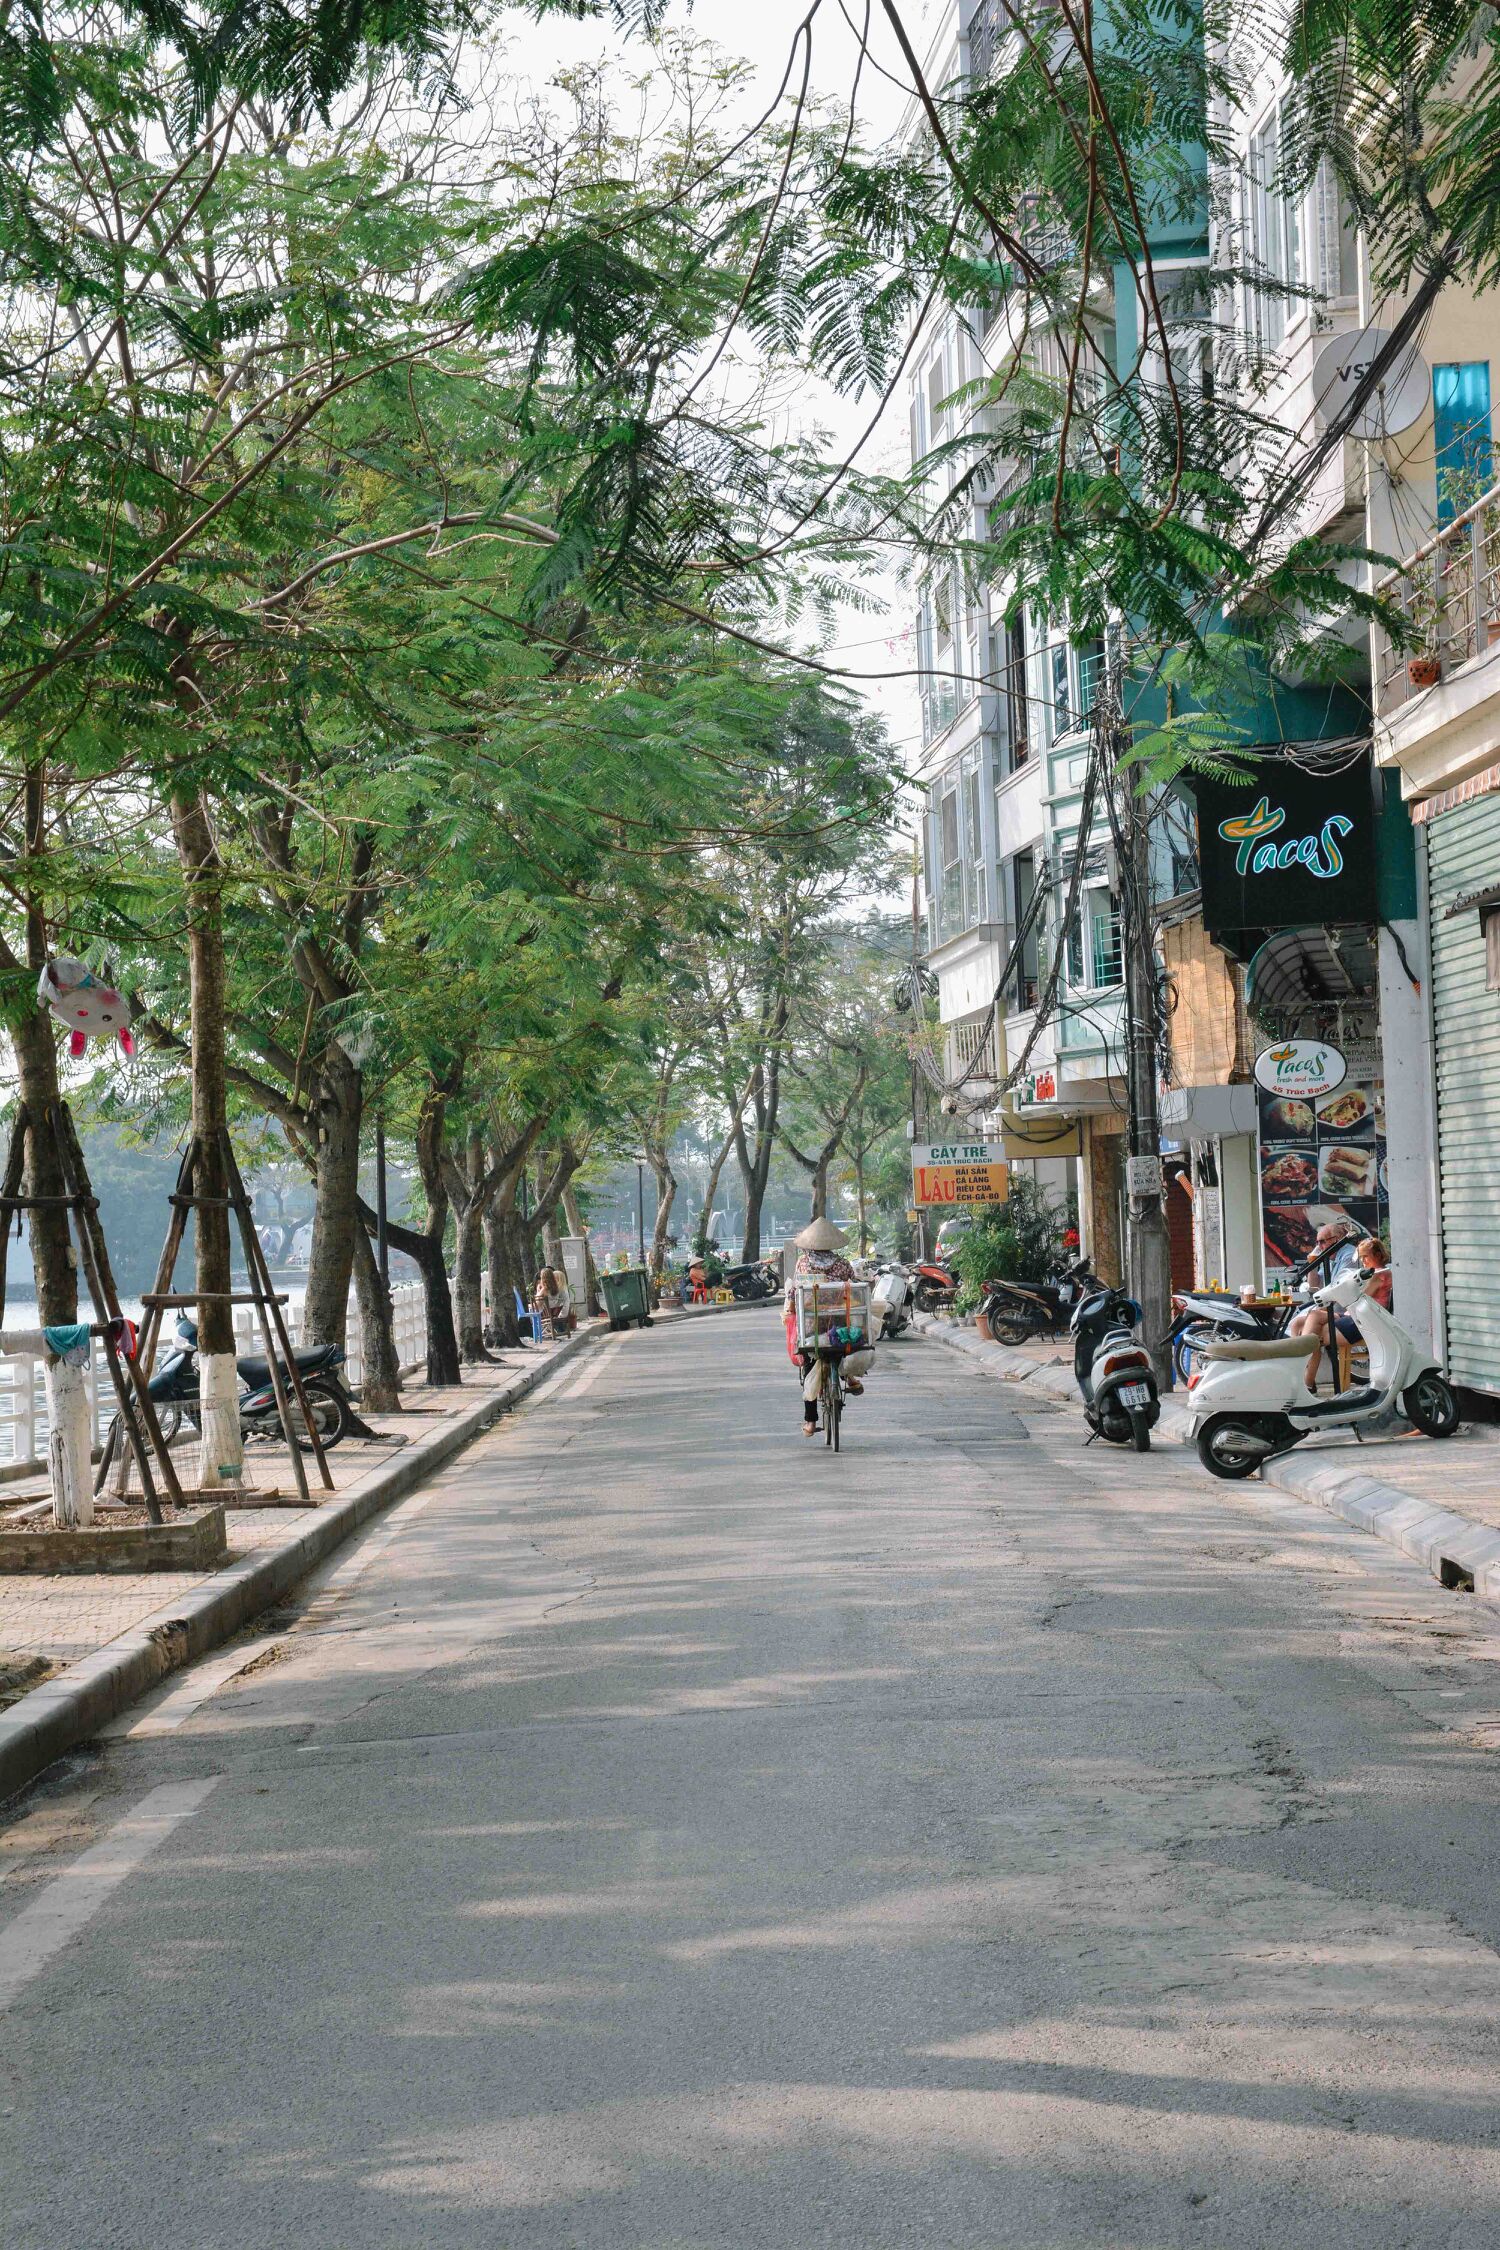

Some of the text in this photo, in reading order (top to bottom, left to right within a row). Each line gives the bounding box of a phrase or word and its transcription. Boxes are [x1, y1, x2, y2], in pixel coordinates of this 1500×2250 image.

[1294, 1075, 1307, 1083] and
[931, 1146, 987, 1159] CÂY TRE
[919, 1168, 955, 1201] LẨU
[1125, 1394, 1147, 1405] 6616
